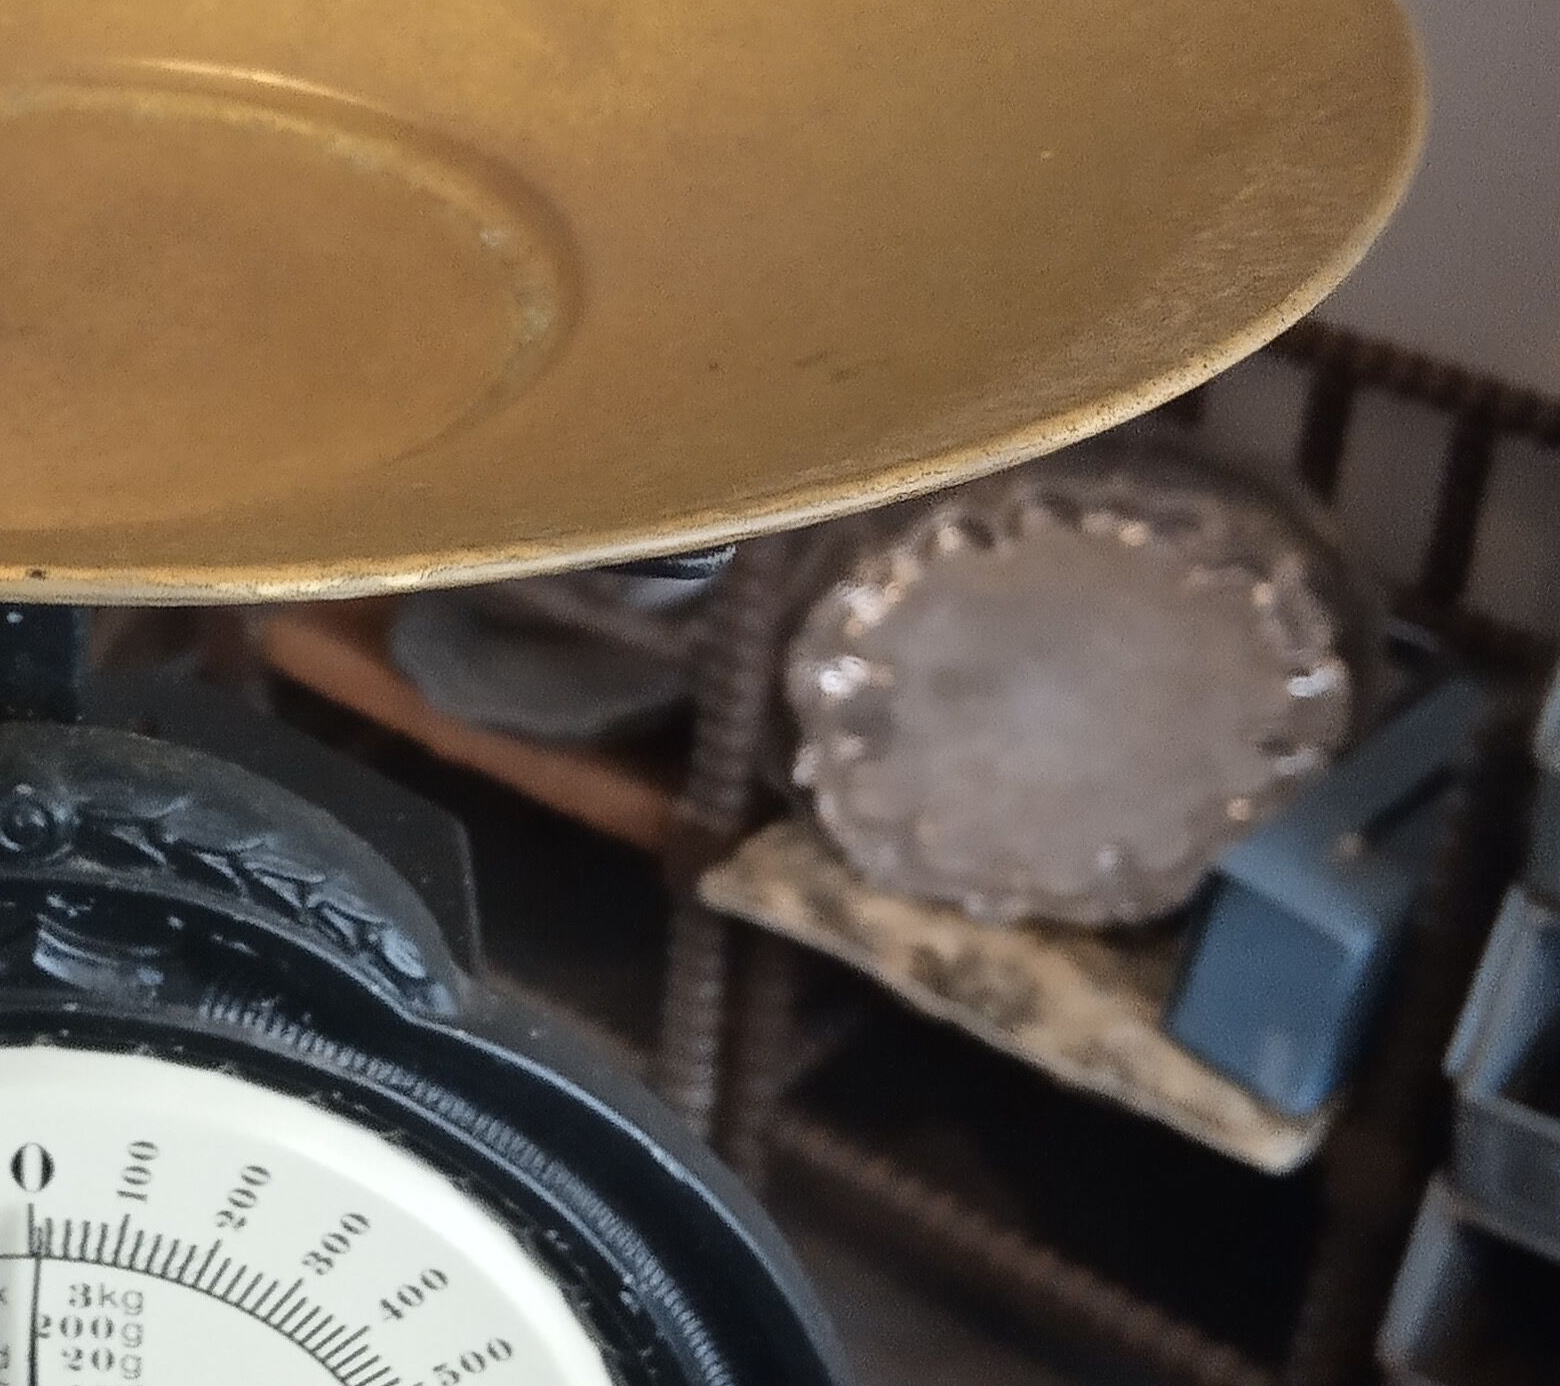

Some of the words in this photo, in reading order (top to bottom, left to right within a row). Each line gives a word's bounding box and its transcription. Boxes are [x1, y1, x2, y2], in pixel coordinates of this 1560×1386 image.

[7, 1142, 57, 1193] 0
[115, 1139, 160, 1204] 100
[215, 1163, 272, 1232] 200
[300, 1211, 372, 1277] 300
[69, 1281, 145, 1316] 3kg
[378, 1267, 450, 1322] 400
[35, 1314, 145, 1349] 200g
[61, 1347, 144, 1380] 20g
